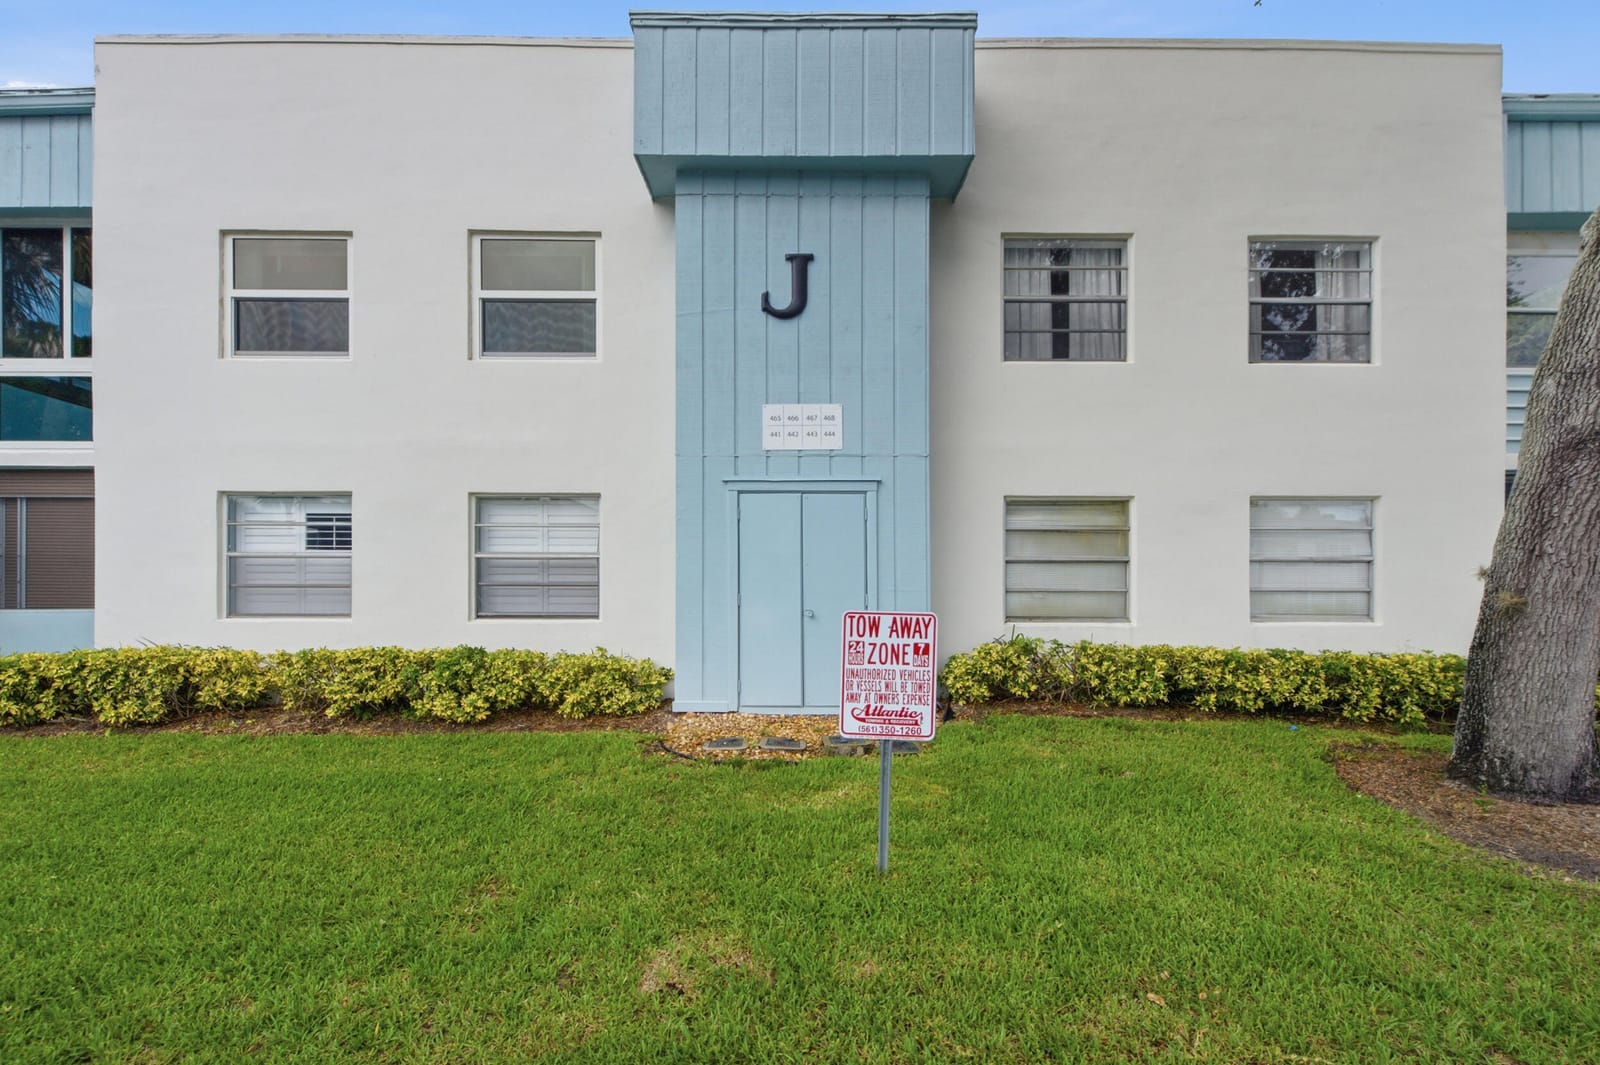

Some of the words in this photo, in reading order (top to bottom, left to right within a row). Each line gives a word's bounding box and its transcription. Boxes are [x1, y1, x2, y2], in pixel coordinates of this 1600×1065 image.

[761, 253, 814, 320] J
[848, 615, 880, 638] TOW
[888, 616, 932, 639] AWAY
[849, 641, 864, 653] 24
[868, 642, 910, 665] ZONE
[916, 643, 924, 655] 7
[848, 653, 864, 664] HOURS
[913, 655, 929, 666] DAYS
[846, 668, 896, 680] UNAUTHORIZED
[899, 670, 931, 681] VEHICLES
[846, 680, 854, 691] OR
[857, 680, 882, 692] VESSELS
[885, 681, 897, 692] WILL
[901, 682, 908, 692] BE
[911, 682, 930, 693] TOWED
[846, 692, 861, 703] AWAY
[864, 693, 871, 703] AT
[874, 693, 900, 704] OWNERS
[902, 694, 930, 706] EXPENSE
[851, 704, 922, 719] Atlantic
[879, 726, 922, 735] 350-1260
